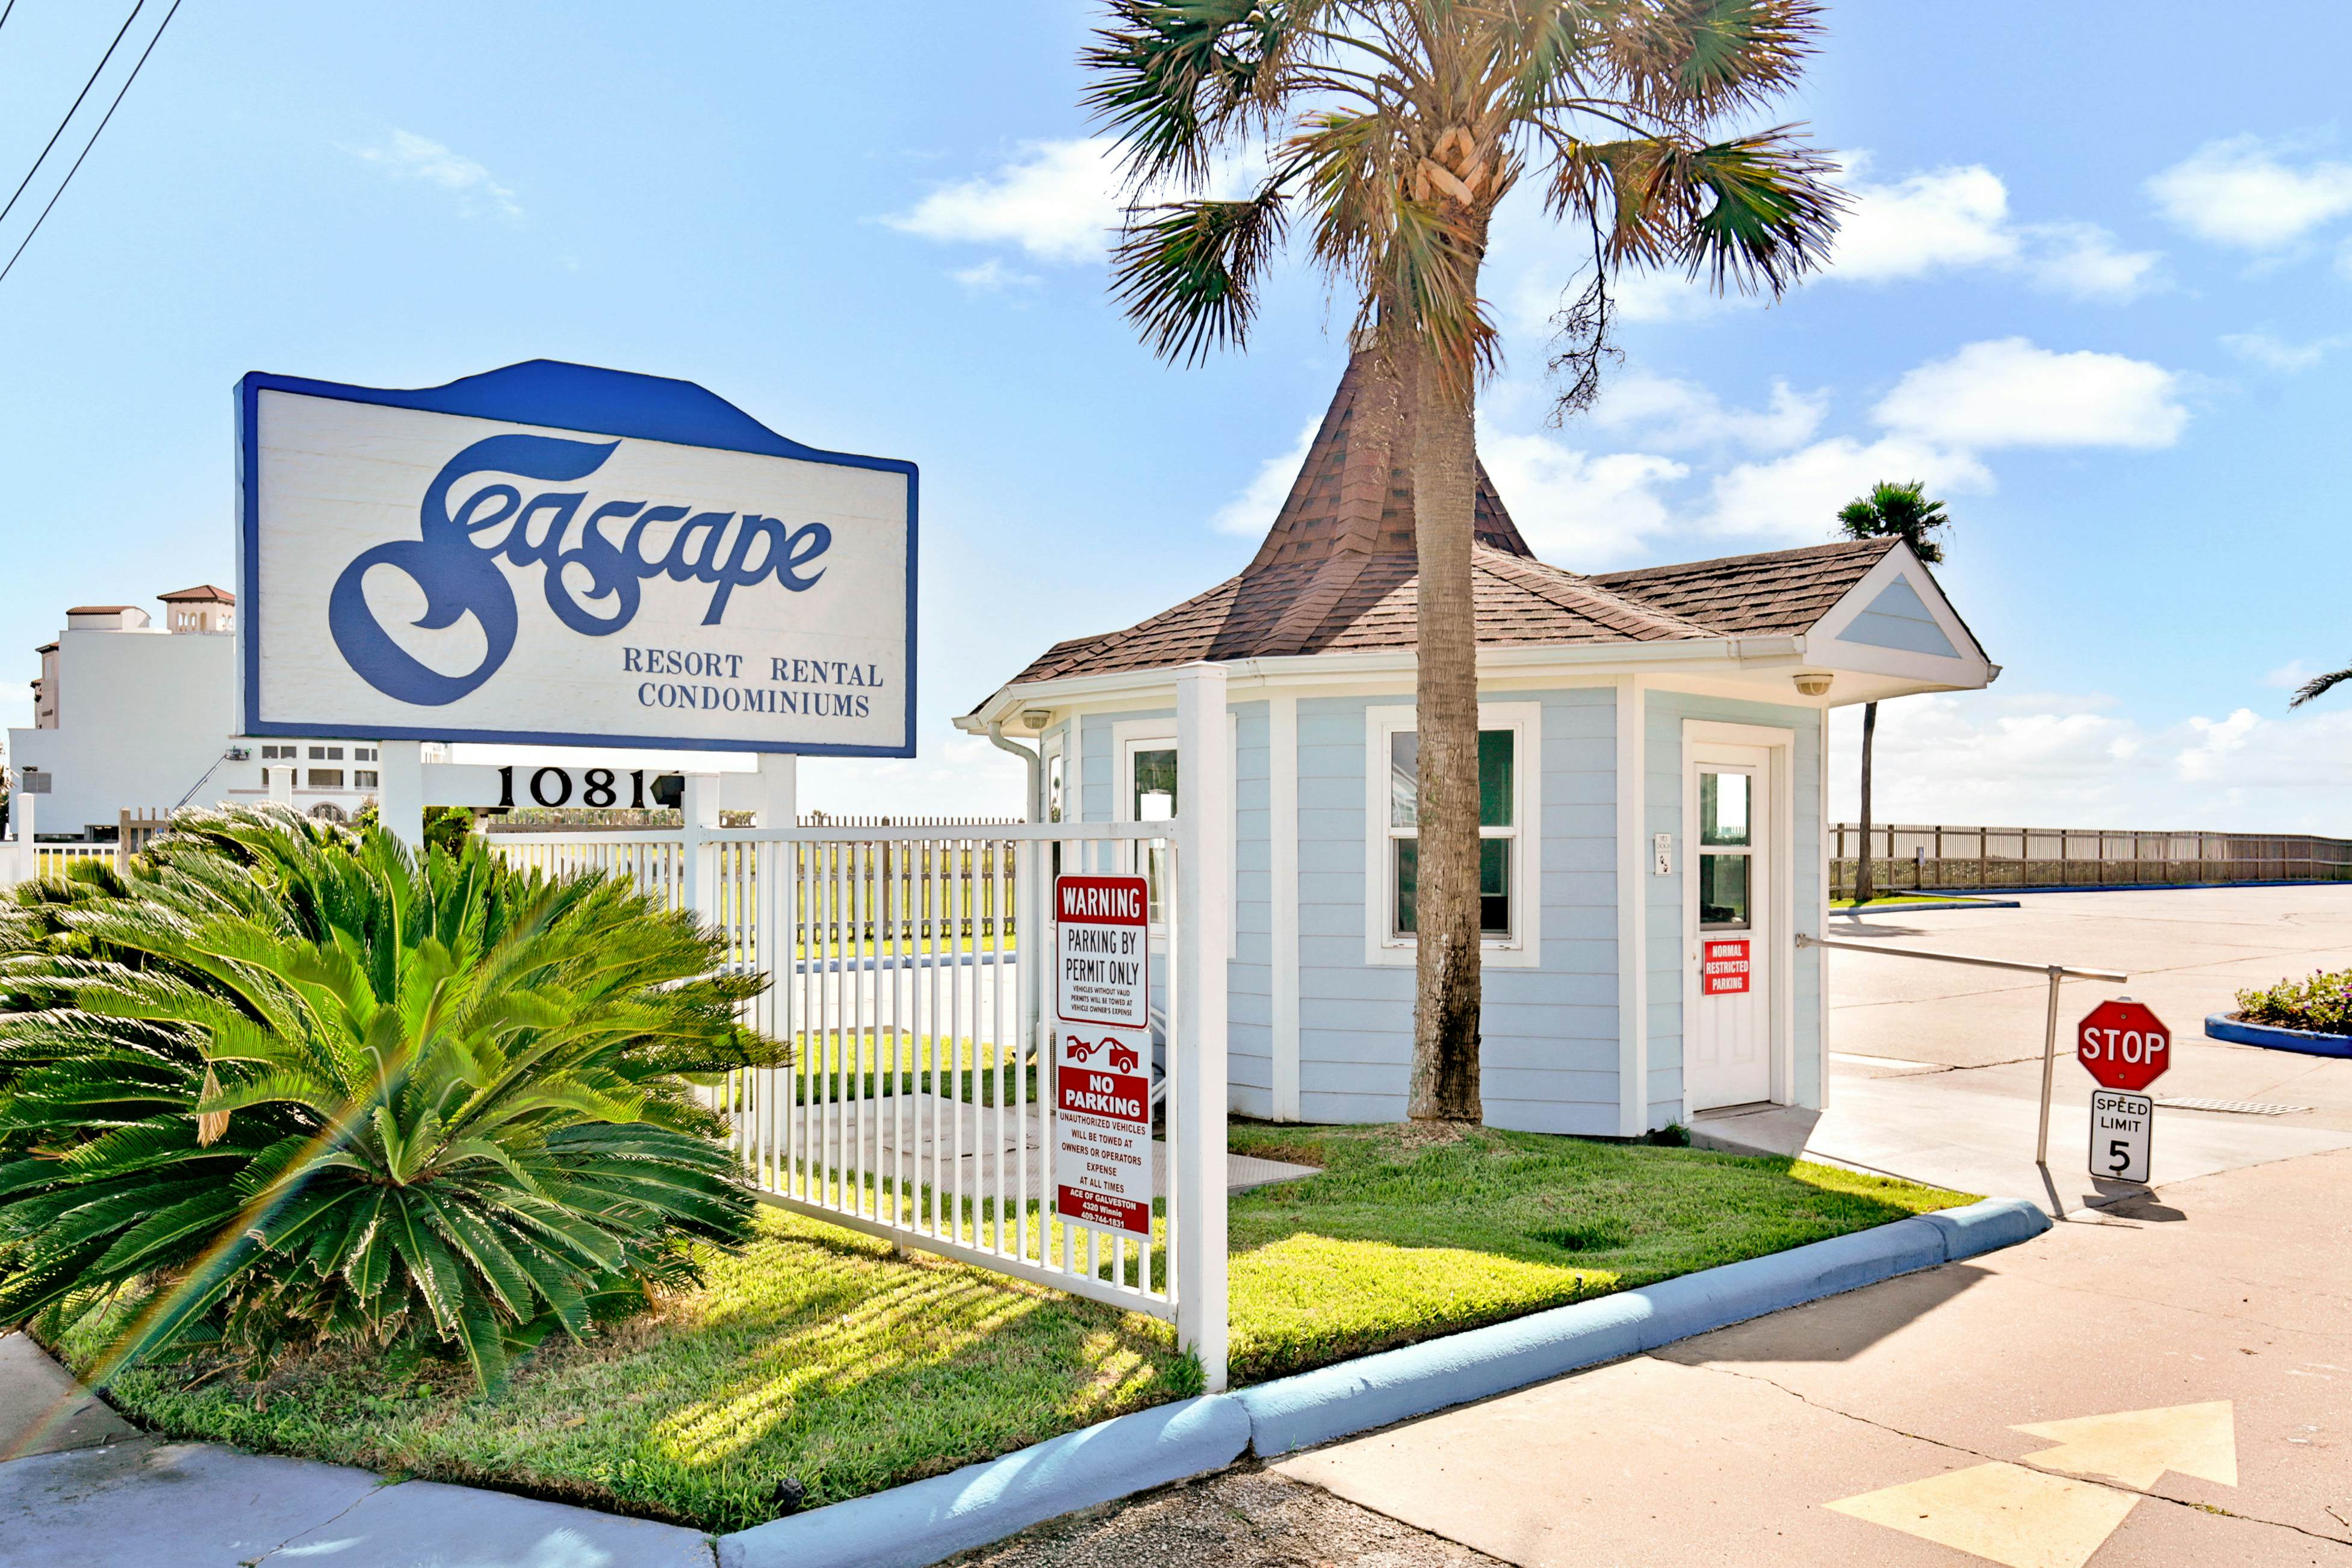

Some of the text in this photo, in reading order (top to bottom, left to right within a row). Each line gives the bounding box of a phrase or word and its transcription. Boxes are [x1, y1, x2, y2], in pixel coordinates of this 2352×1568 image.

[622, 647, 883, 687] RESORT RENTAL
[638, 683, 869, 717] CONDOMINIUMS
[498, 766, 680, 808] 1081
[1063, 887, 1140, 918] WARNING
[1069, 929, 1137, 955] PARKING BY
[1712, 944, 1742, 958] NORMAL
[1066, 958, 1139, 986] PERMIT ONLY
[1706, 960, 1749, 975] RESTRICTED
[1073, 985, 1093, 994] VEHICLES
[1094, 987, 1115, 995] WITHOUT
[1712, 977, 1742, 991] PARKING
[1090, 1006, 1111, 1014] OWNER'S
[2082, 1027, 2165, 1064] STOP
[1089, 1074, 1114, 1094] NO
[1065, 1089, 1141, 1117] PARKING
[2096, 1099, 2148, 1115] SPEED
[1060, 1112, 1146, 1135] UNAUTHORIZED VEHICLES
[2101, 1117, 2141, 1133] LIMIT
[1071, 1129, 1132, 1148] WILL BE TOWED AT
[1061, 1142, 1141, 1166] OWNERS OR OPERATORS
[2108, 1140, 2130, 1172] 5
[1087, 1162, 1117, 1176] EXPENSE
[1080, 1176, 1124, 1193] AT ALL TIMES
[1070, 1188, 1083, 1198] ACE
[1094, 1194, 1137, 1210] GALVESTON
[1082, 1201, 1122, 1217] 4320 Winnie
[1081, 1211, 1125, 1228] 409-744-1831
